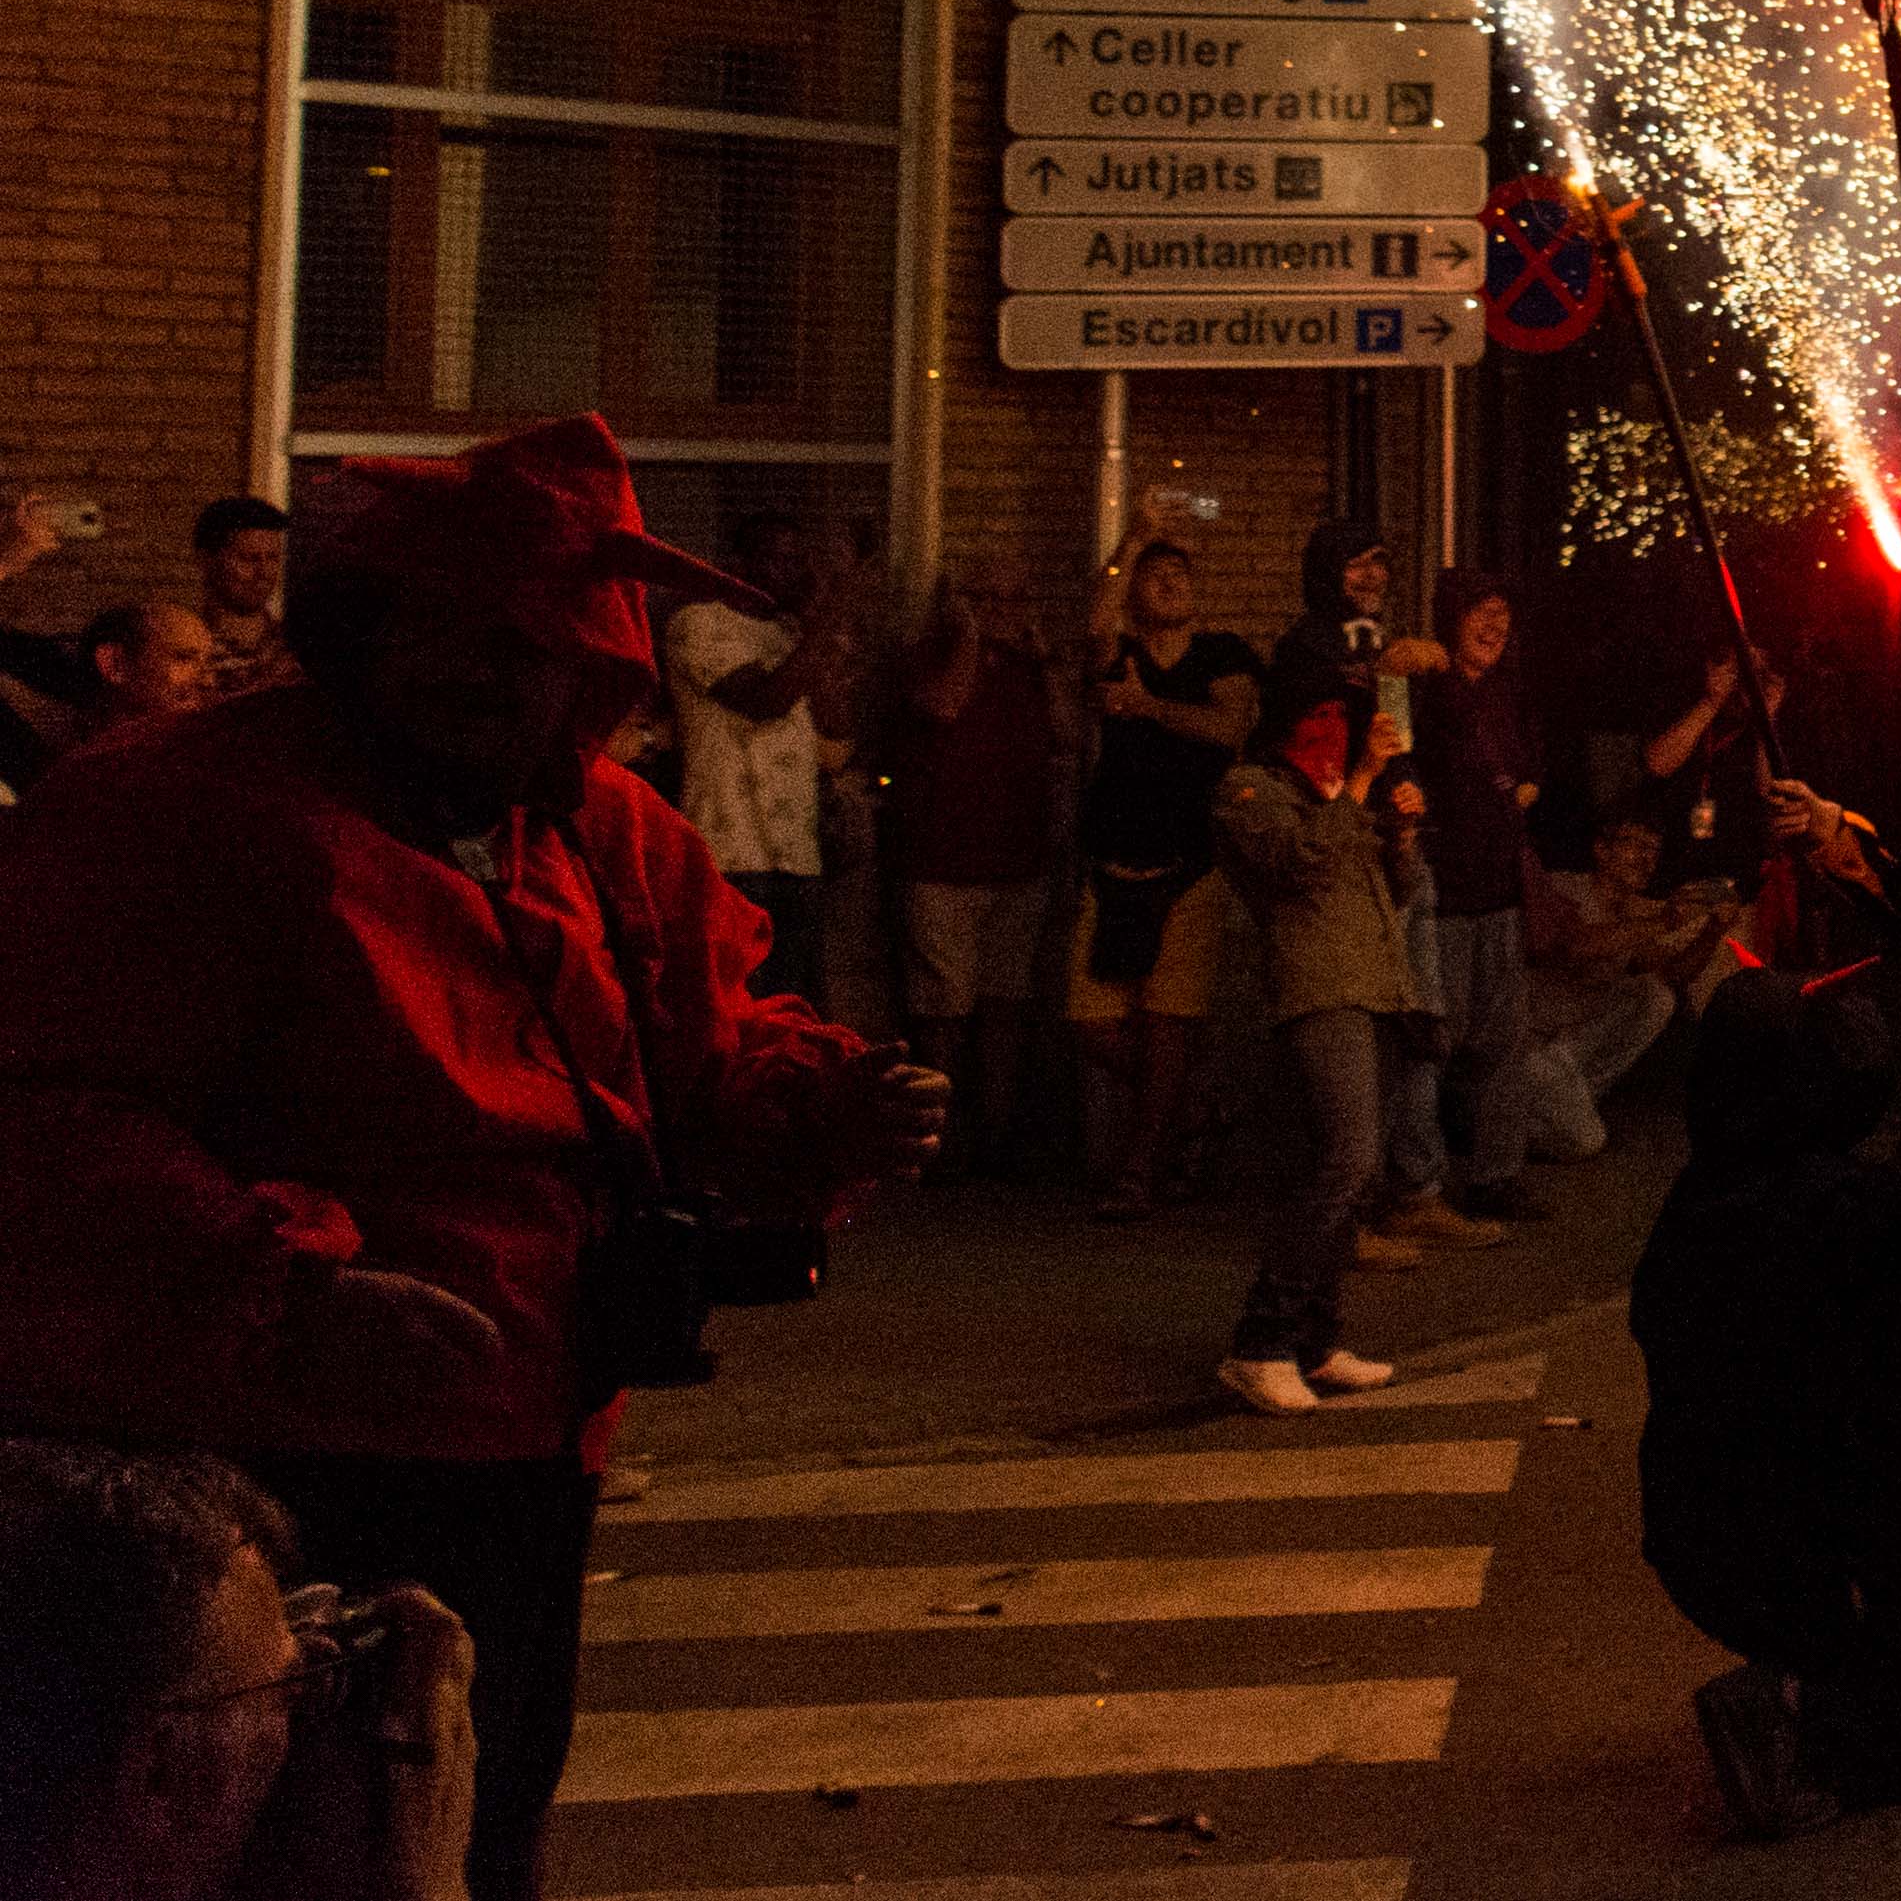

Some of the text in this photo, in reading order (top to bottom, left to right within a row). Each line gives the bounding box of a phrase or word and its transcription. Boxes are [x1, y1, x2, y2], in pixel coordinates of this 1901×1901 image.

[1090, 27, 1244, 67] Celler
[1089, 84, 1370, 126] cooperatiu
[1086, 152, 1258, 200] Jutjats
[1084, 230, 1354, 276] Ajuntament
